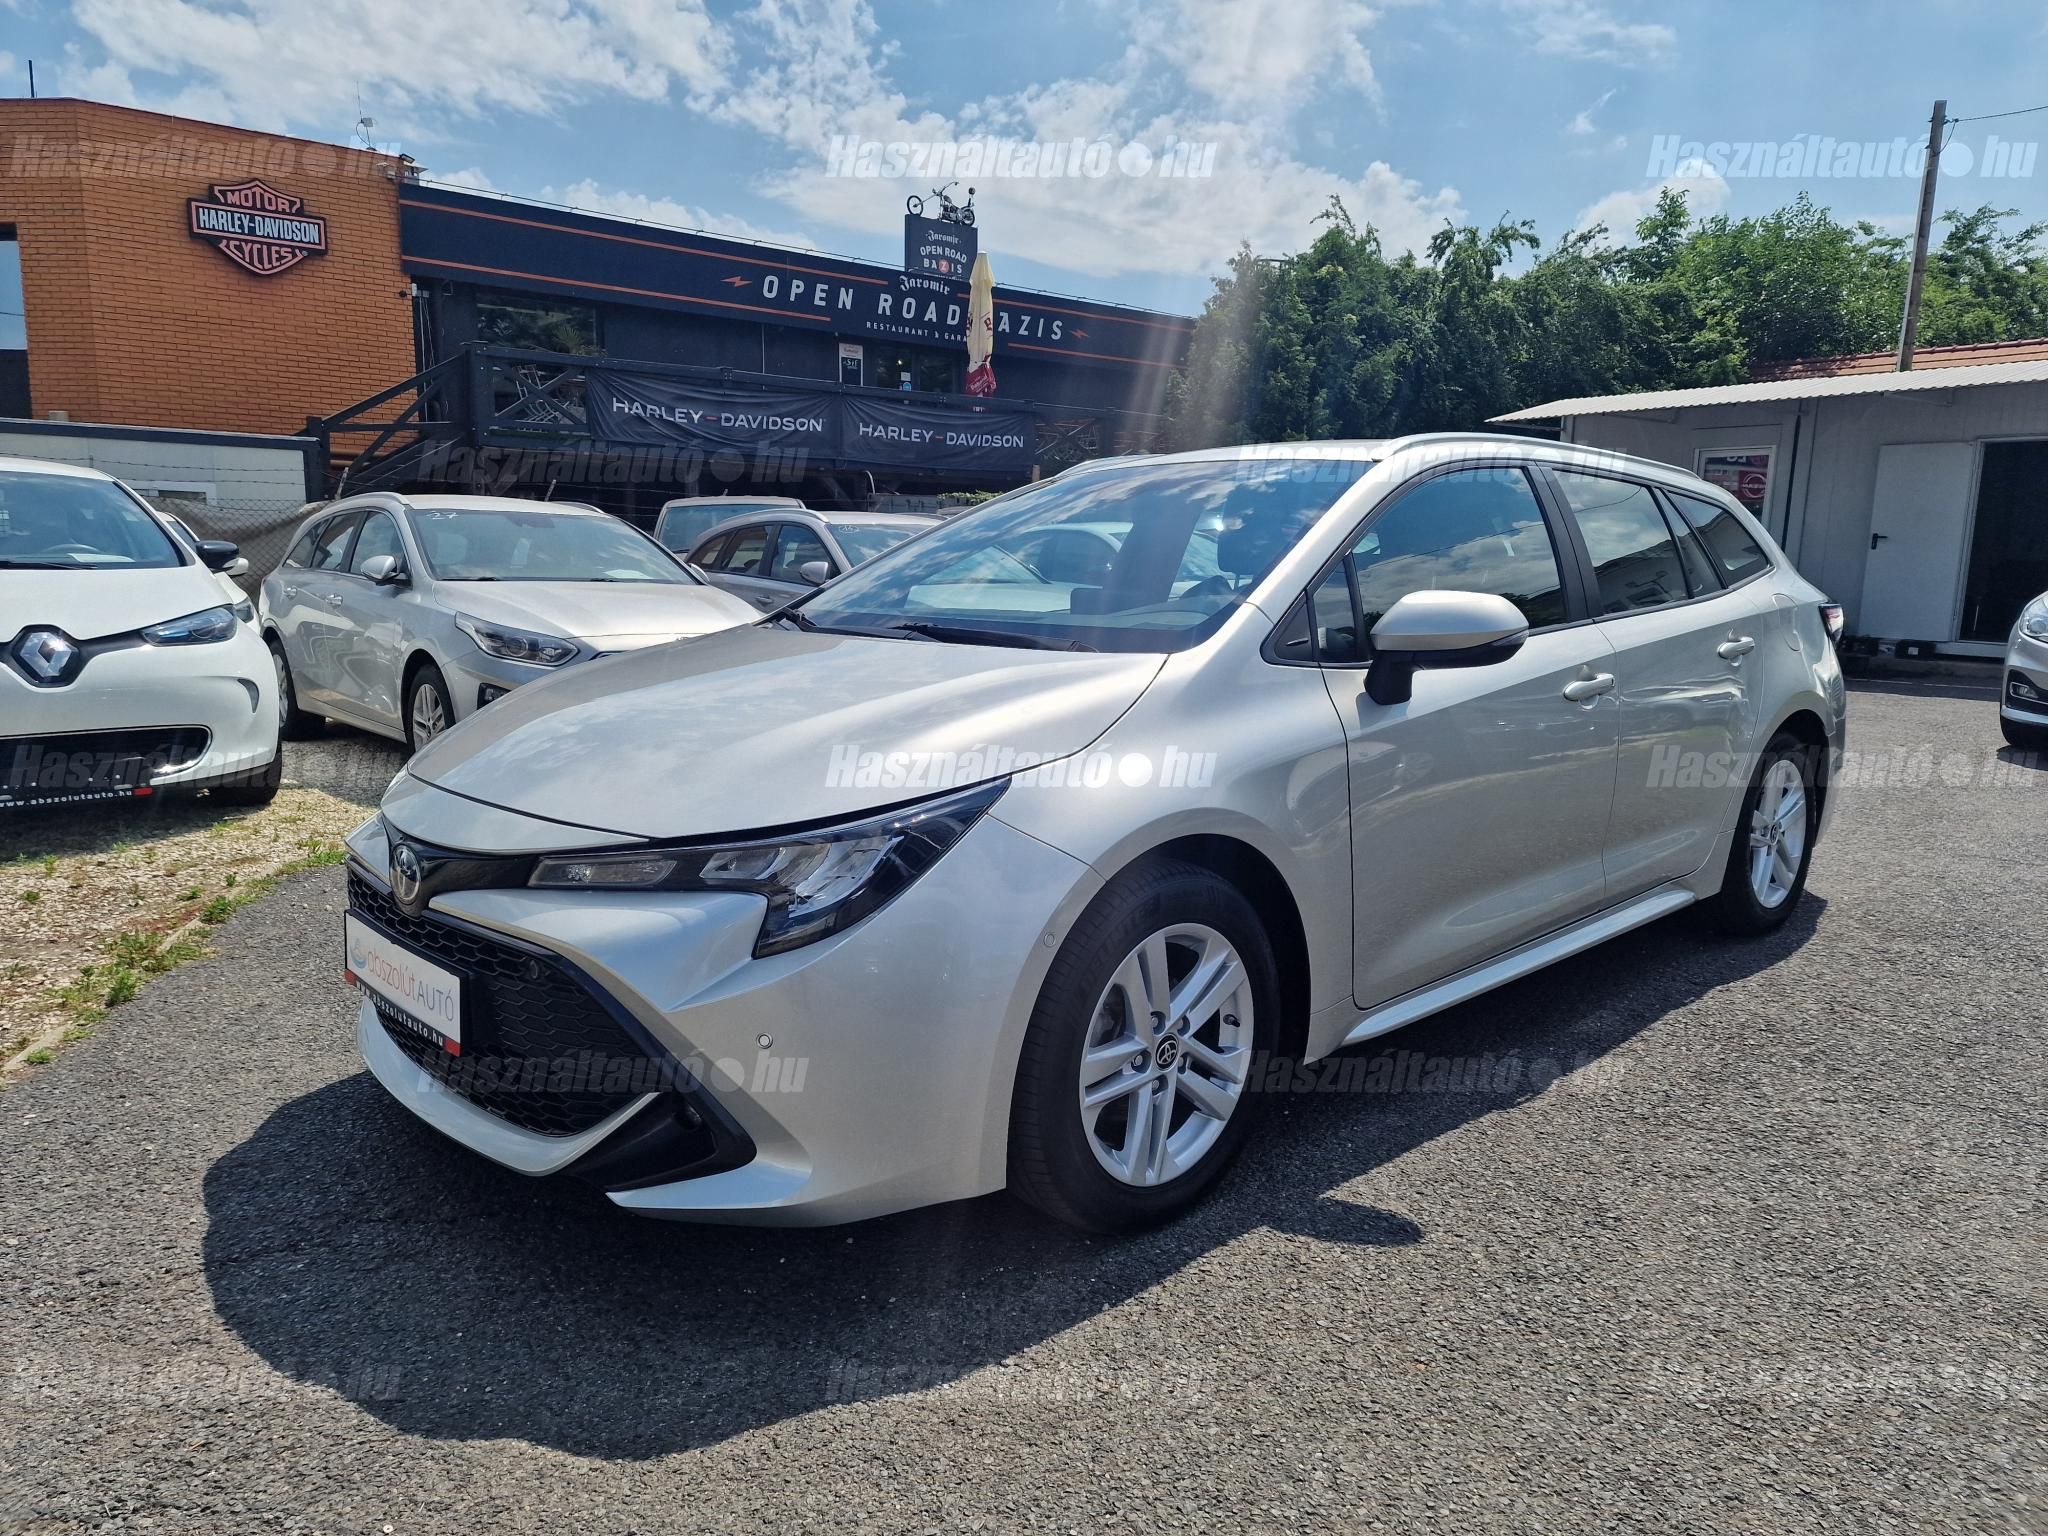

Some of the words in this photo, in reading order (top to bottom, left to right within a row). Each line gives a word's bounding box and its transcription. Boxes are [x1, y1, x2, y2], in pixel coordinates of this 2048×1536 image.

[226, 187, 291, 213] MOTOR
[199, 208, 320, 244] HARLEY-DAVIDSON
[229, 240, 292, 270] CYCLES
[920, 245, 943, 256] OPEN
[944, 247, 968, 263] ROAD
[923, 258, 963, 274] BAZIS
[900, 275, 951, 295] Jaromir
[762, 275, 854, 311] OPEN
[877, 293, 961, 325] ROAD
[998, 311, 1064, 341] AZIS
[866, 321, 929, 337] RESTAURANT
[944, 332, 967, 342] GARA
